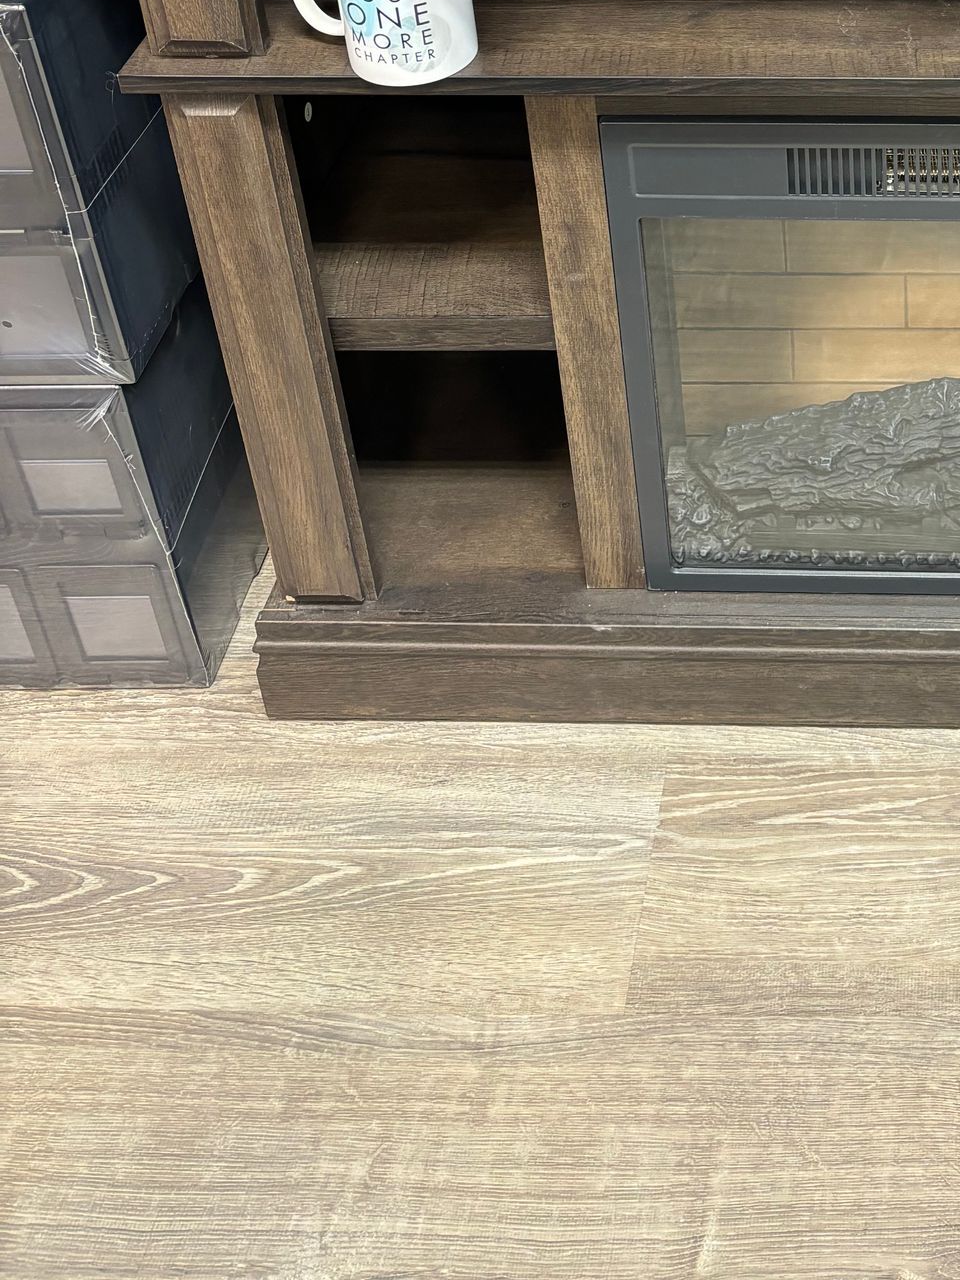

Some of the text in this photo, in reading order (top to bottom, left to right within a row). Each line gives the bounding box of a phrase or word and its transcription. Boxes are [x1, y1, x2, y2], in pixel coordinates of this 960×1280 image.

[347, 2, 430, 29] ONE
[351, 27, 434, 50] MORE
[354, 48, 436, 64] CHAPTER
